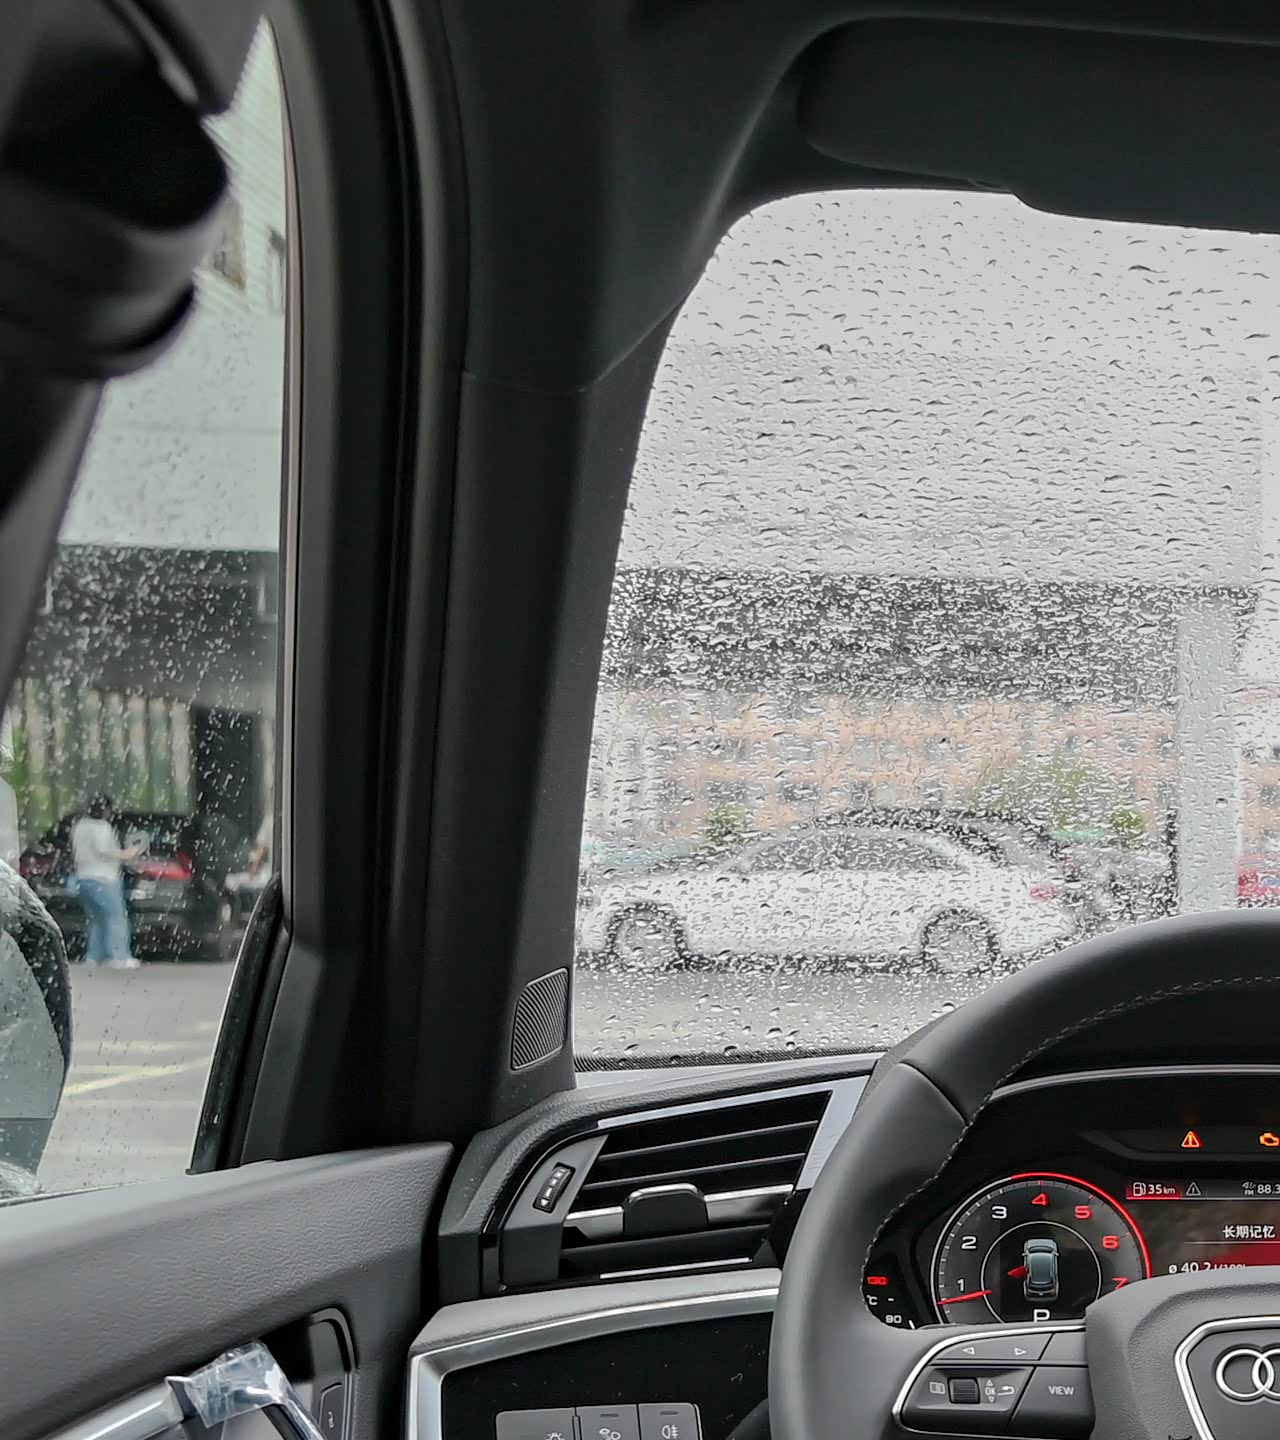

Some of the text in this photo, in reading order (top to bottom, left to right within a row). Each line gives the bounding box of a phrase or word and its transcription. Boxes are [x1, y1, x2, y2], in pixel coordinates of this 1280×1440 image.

[1031, 1193, 1049, 1207] 4
[992, 1206, 1007, 1219] 3
[1075, 1205, 1093, 1220] 5
[1223, 1225, 1276, 1239] 长期记忆
[961, 1235, 977, 1249] 2
[1102, 1235, 1120, 1249] 6
[957, 1278, 965, 1291] 1
[885, 1314, 902, 1324] 90
[1033, 1309, 1050, 1323] P
[985, 1387, 996, 1396] OK
[1048, 1385, 1075, 1396] VIEW
